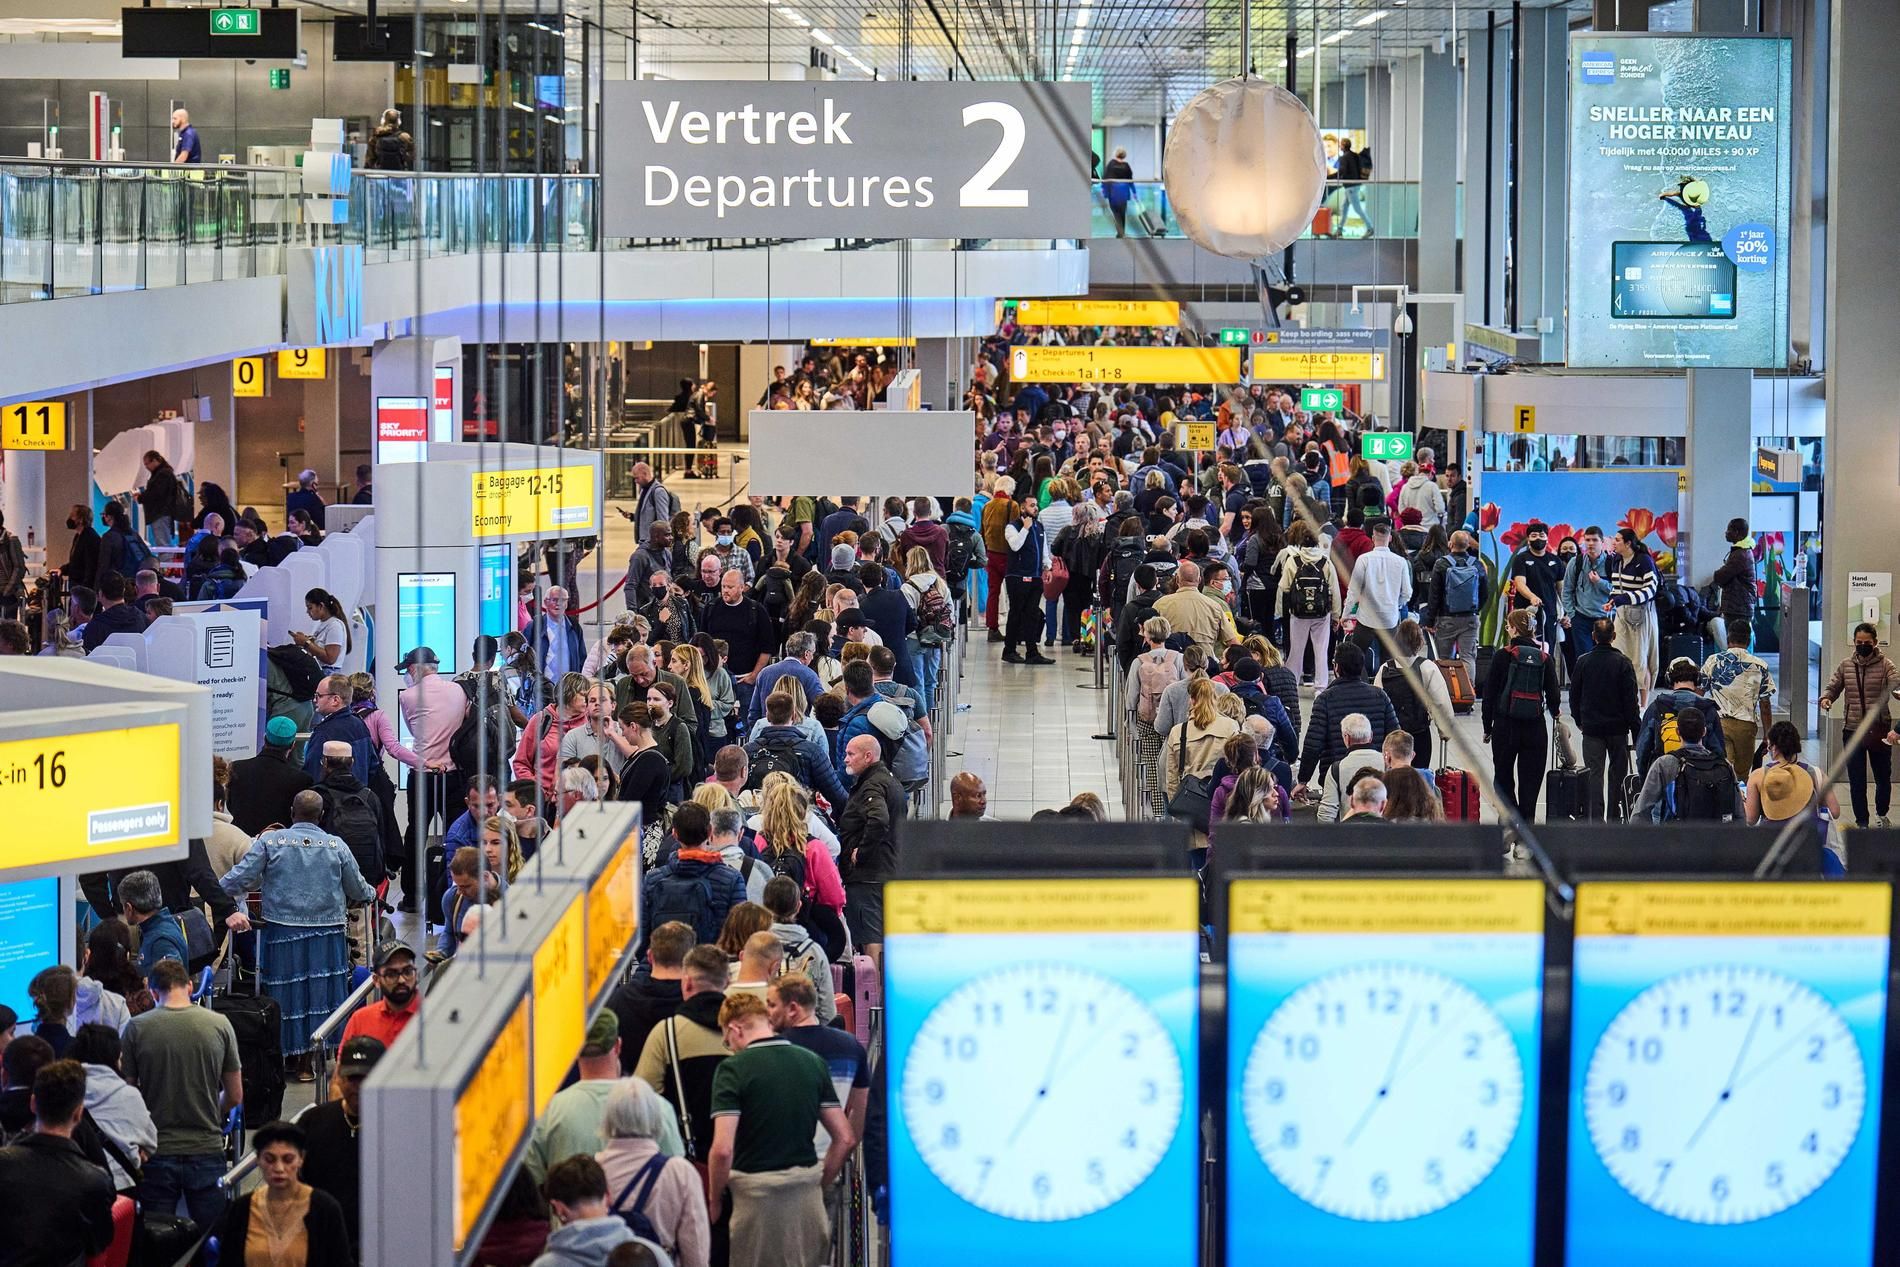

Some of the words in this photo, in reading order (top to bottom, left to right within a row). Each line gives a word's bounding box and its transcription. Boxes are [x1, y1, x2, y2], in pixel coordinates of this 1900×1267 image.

[1620, 64, 1653, 72] moment
[641, 98, 853, 144] Vertrek
[1590, 106, 1673, 122] SNELLER
[1679, 107, 1731, 122] NAAR
[1737, 107, 1774, 122] EEN
[1610, 125, 1677, 140] HOGER
[1682, 125, 1752, 140] NIVEAU
[959, 101, 1029, 208] 2
[1600, 148, 1635, 156] Tijdelijk
[1656, 148, 1690, 156] 40.000
[1693, 148, 1721, 156] MILES
[1732, 148, 1744, 156] 90
[1746, 148, 1759, 156] XP
[1624, 164, 1642, 172] Vraag
[644, 164, 934, 218] Departures
[1736, 241, 1768, 253] 50%
[1748, 232, 1764, 240] jaar
[1737, 255, 1767, 264] korting
[316, 247, 362, 345] KLM
[1281, 330, 1298, 339] Keep
[294, 349, 308, 367] 9
[1042, 349, 1085, 358] Departures
[1088, 352, 1093, 362] 1
[1300, 355, 1308, 363] A
[1310, 355, 1317, 363] B
[1320, 355, 1327, 363] C
[1332, 355, 1339, 363] D
[1042, 368, 1075, 376] Check-in
[1078, 368, 1092, 378] 1a
[14, 406, 49, 434] 11
[1520, 410, 1529, 429] F
[490, 476, 525, 489] Baggage
[527, 474, 563, 496] 12-15
[475, 515, 512, 527] Economy
[34, 751, 66, 789] 16
[92, 816, 143, 834] Passengers
[146, 812, 166, 828] only
[1023, 989, 1058, 1013] 12
[1368, 989, 1402, 1013] 12
[1712, 991, 1747, 1015] 12
[974, 1003, 1002, 1026] 11
[1087, 1003, 1096, 1024] 1
[1317, 1003, 1345, 1025] 11
[1430, 1003, 1439, 1025] 1
[1662, 1005, 1689, 1028] 11
[1775, 1005, 1783, 1028] 1
[943, 1035, 977, 1061] 10
[1121, 1033, 1139, 1057] 2
[1284, 1035, 1320, 1061] 10
[1463, 1033, 1482, 1058] 2
[1628, 1038, 1662, 1063] 10
[1807, 1036, 1826, 1062] 2
[926, 1078, 944, 1105] 9
[1141, 1080, 1158, 1105] 3
[1266, 1078, 1285, 1105] 9
[1480, 1080, 1499, 1106] 3
[1608, 1082, 1627, 1107] 9
[1823, 1083, 1841, 1109] 3
[1121, 1128, 1136, 1149] 4
[1460, 1128, 1476, 1150] 4
[1801, 1130, 1818, 1153] 4
[977, 1157, 994, 1181] 7
[1087, 1158, 1104, 1185] 5
[1314, 1157, 1332, 1181] 7
[1424, 1158, 1443, 1185] 5
[1656, 1160, 1674, 1183] 7
[1766, 1162, 1784, 1187] 5
[1032, 1172, 1050, 1198] 6
[1370, 1172, 1389, 1198] 6
[1711, 1175, 1730, 1201] 6
